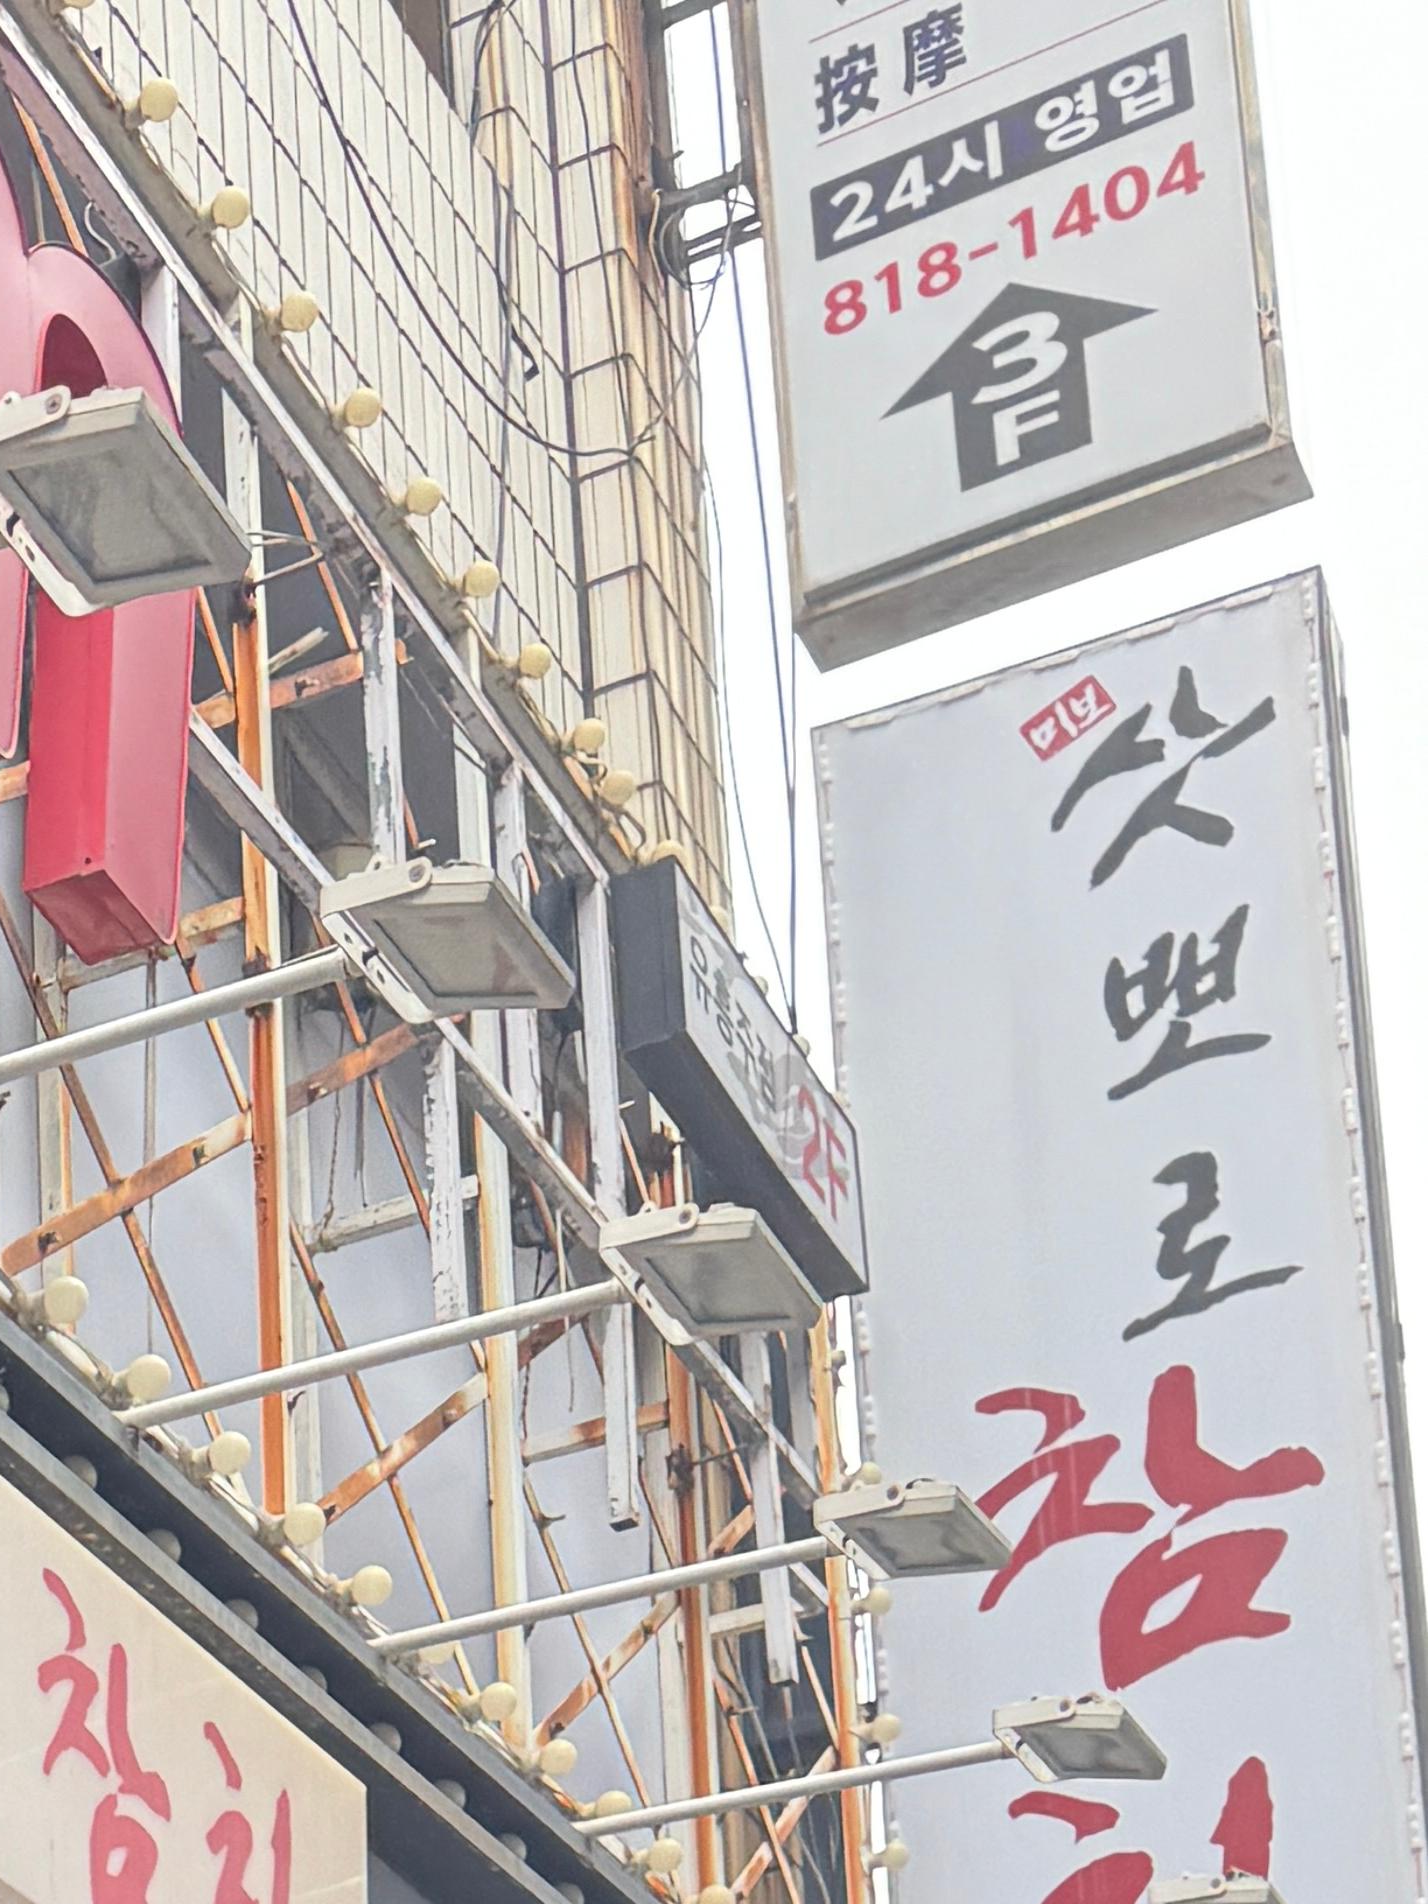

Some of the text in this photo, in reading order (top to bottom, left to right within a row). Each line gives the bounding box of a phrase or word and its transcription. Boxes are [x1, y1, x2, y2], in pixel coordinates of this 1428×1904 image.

[822, 140, 1205, 338] 818-1404
[831, 57, 1177, 243] 24시 영업
